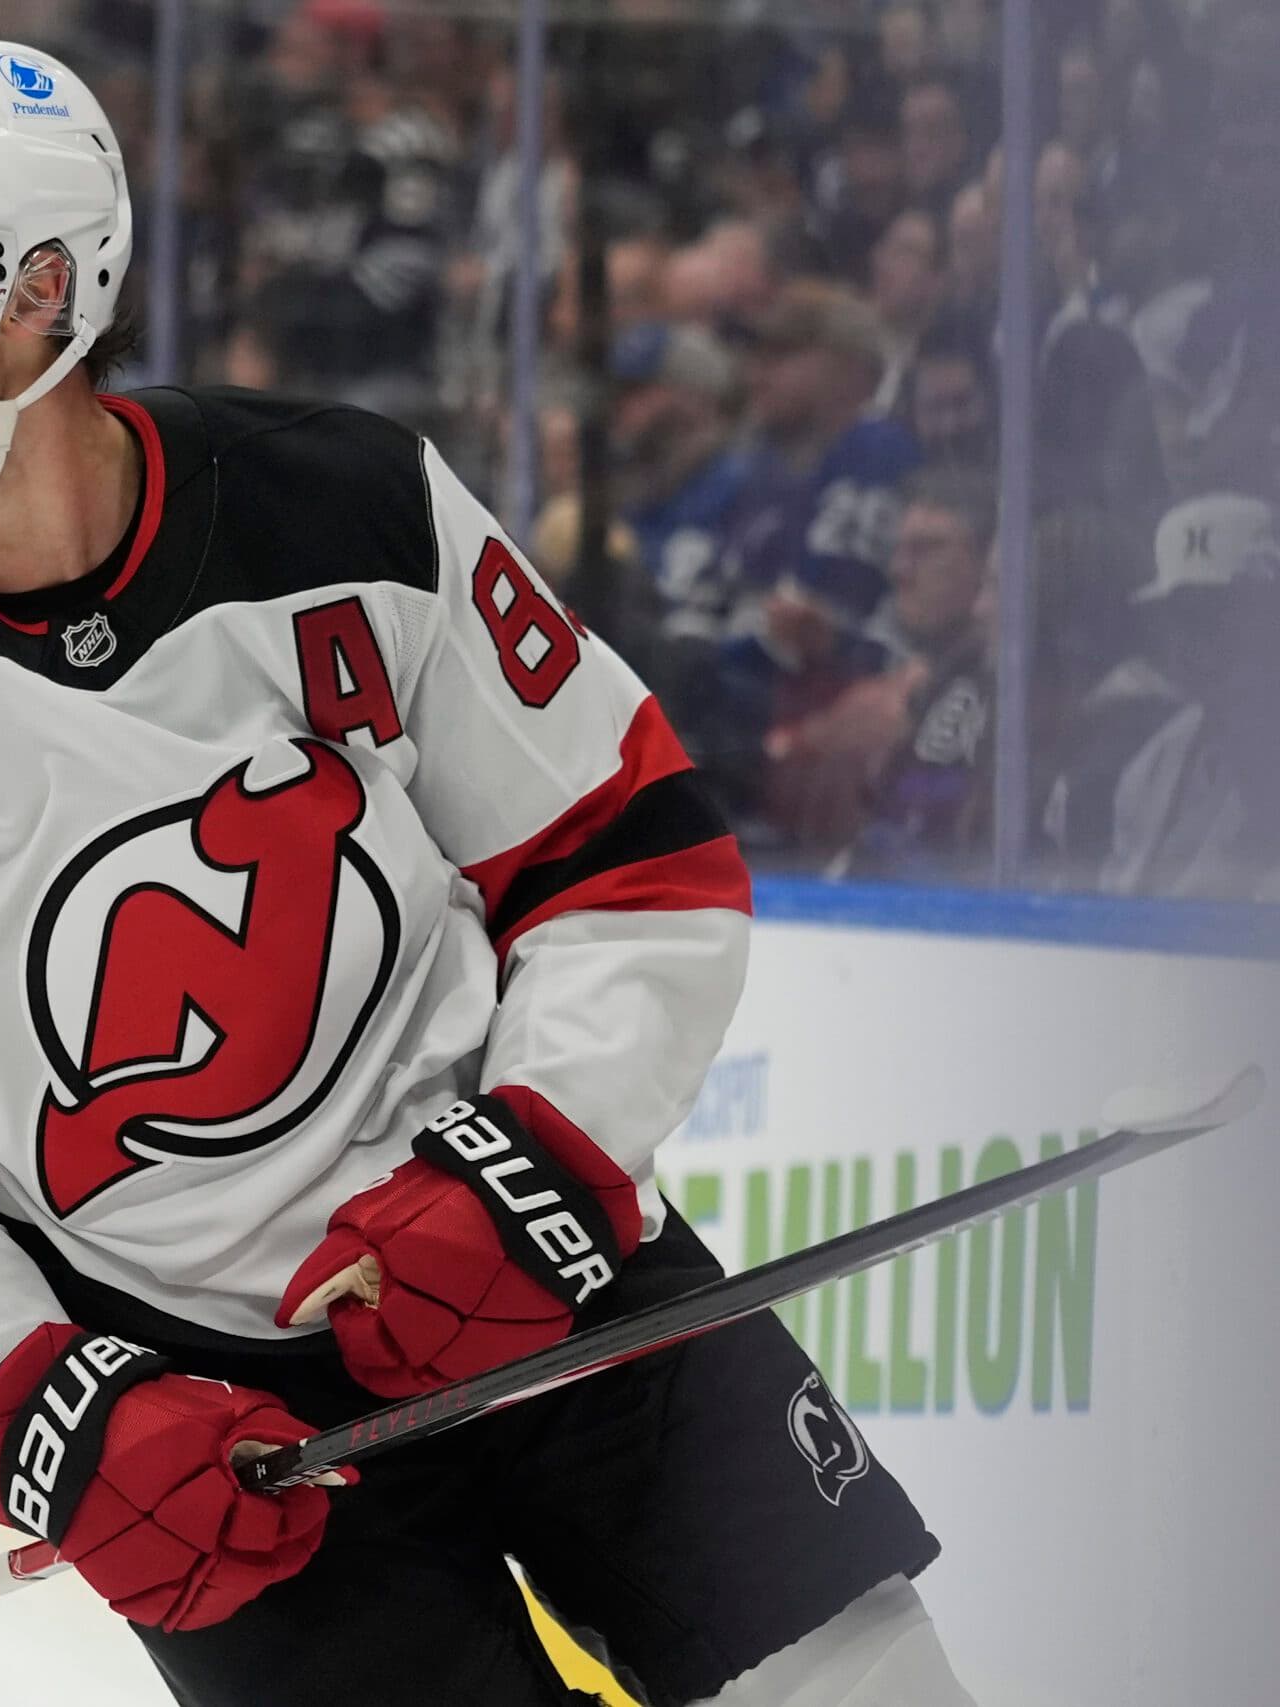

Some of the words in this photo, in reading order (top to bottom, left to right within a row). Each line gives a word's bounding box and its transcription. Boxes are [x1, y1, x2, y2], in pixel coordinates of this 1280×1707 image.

[11, 102, 70, 117] Prudential
[78, 628, 103, 661] NHL
[293, 596, 404, 748] A
[472, 536, 589, 709] 8
[744, 1128, 1099, 1415] MILLION
